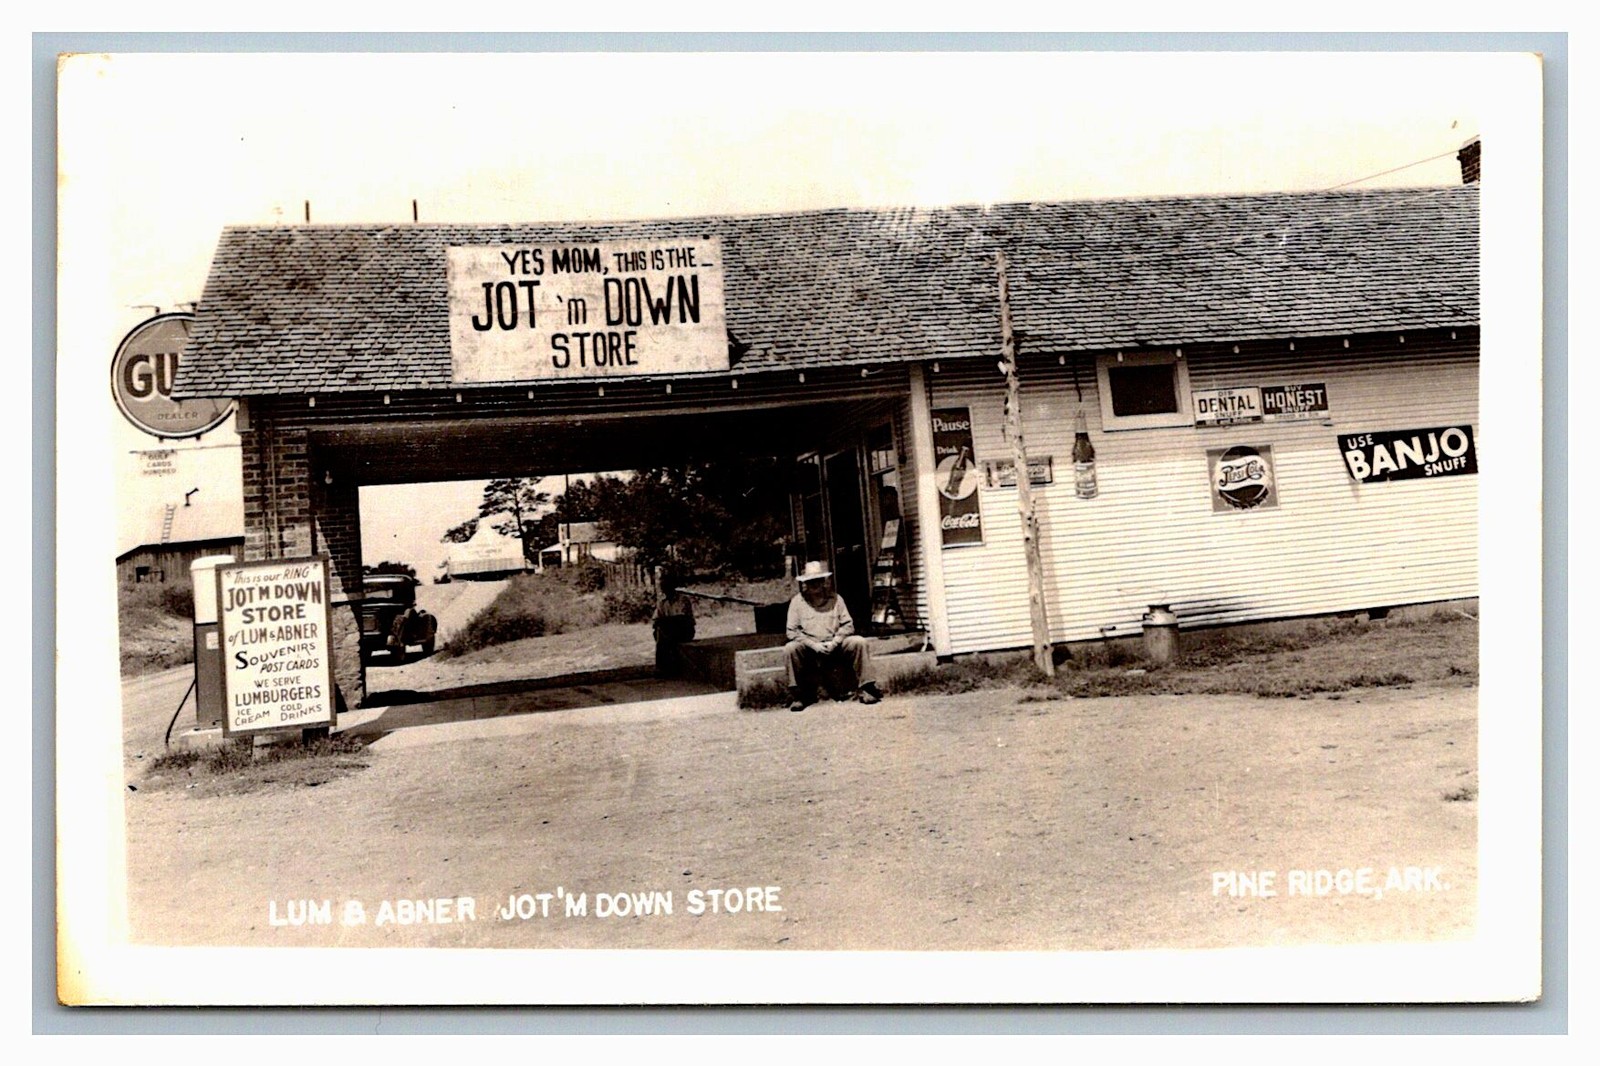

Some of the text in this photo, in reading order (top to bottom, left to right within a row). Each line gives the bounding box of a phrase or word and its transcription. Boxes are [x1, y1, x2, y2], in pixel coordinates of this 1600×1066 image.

[501, 248, 544, 275] YES
[552, 248, 609, 276] MOM,
[613, 251, 647, 272] THIS
[651, 250, 665, 270] IS
[472, 280, 540, 331] JOT
[604, 274, 700, 327] DOWN
[551, 331, 638, 369] STORE
[124, 353, 179, 399] GU
[1198, 395, 1255, 413] DENTAL
[1265, 389, 1323, 409] HONEST
[157, 411, 199, 420] DEALER
[1281, 405, 1310, 413] SNUFF
[932, 418, 970, 433] Pause
[1347, 434, 1374, 449] USE
[1345, 427, 1468, 481] BANJO
[1424, 456, 1467, 476] SNUFF
[263, 573, 282, 582] our
[275, 581, 322, 604] DOWN
[242, 604, 306, 624] STORE
[229, 623, 318, 646] of LUM & ABNER
[260, 658, 320, 673] POST CARDS
[254, 675, 302, 688] WE SERVE
[235, 685, 321, 707] LUMBURGERS
[238, 708, 251, 716] ICE
[280, 703, 302, 711] COLD
[280, 704, 322, 721] DRINKS
[235, 710, 270, 726] CREAM
